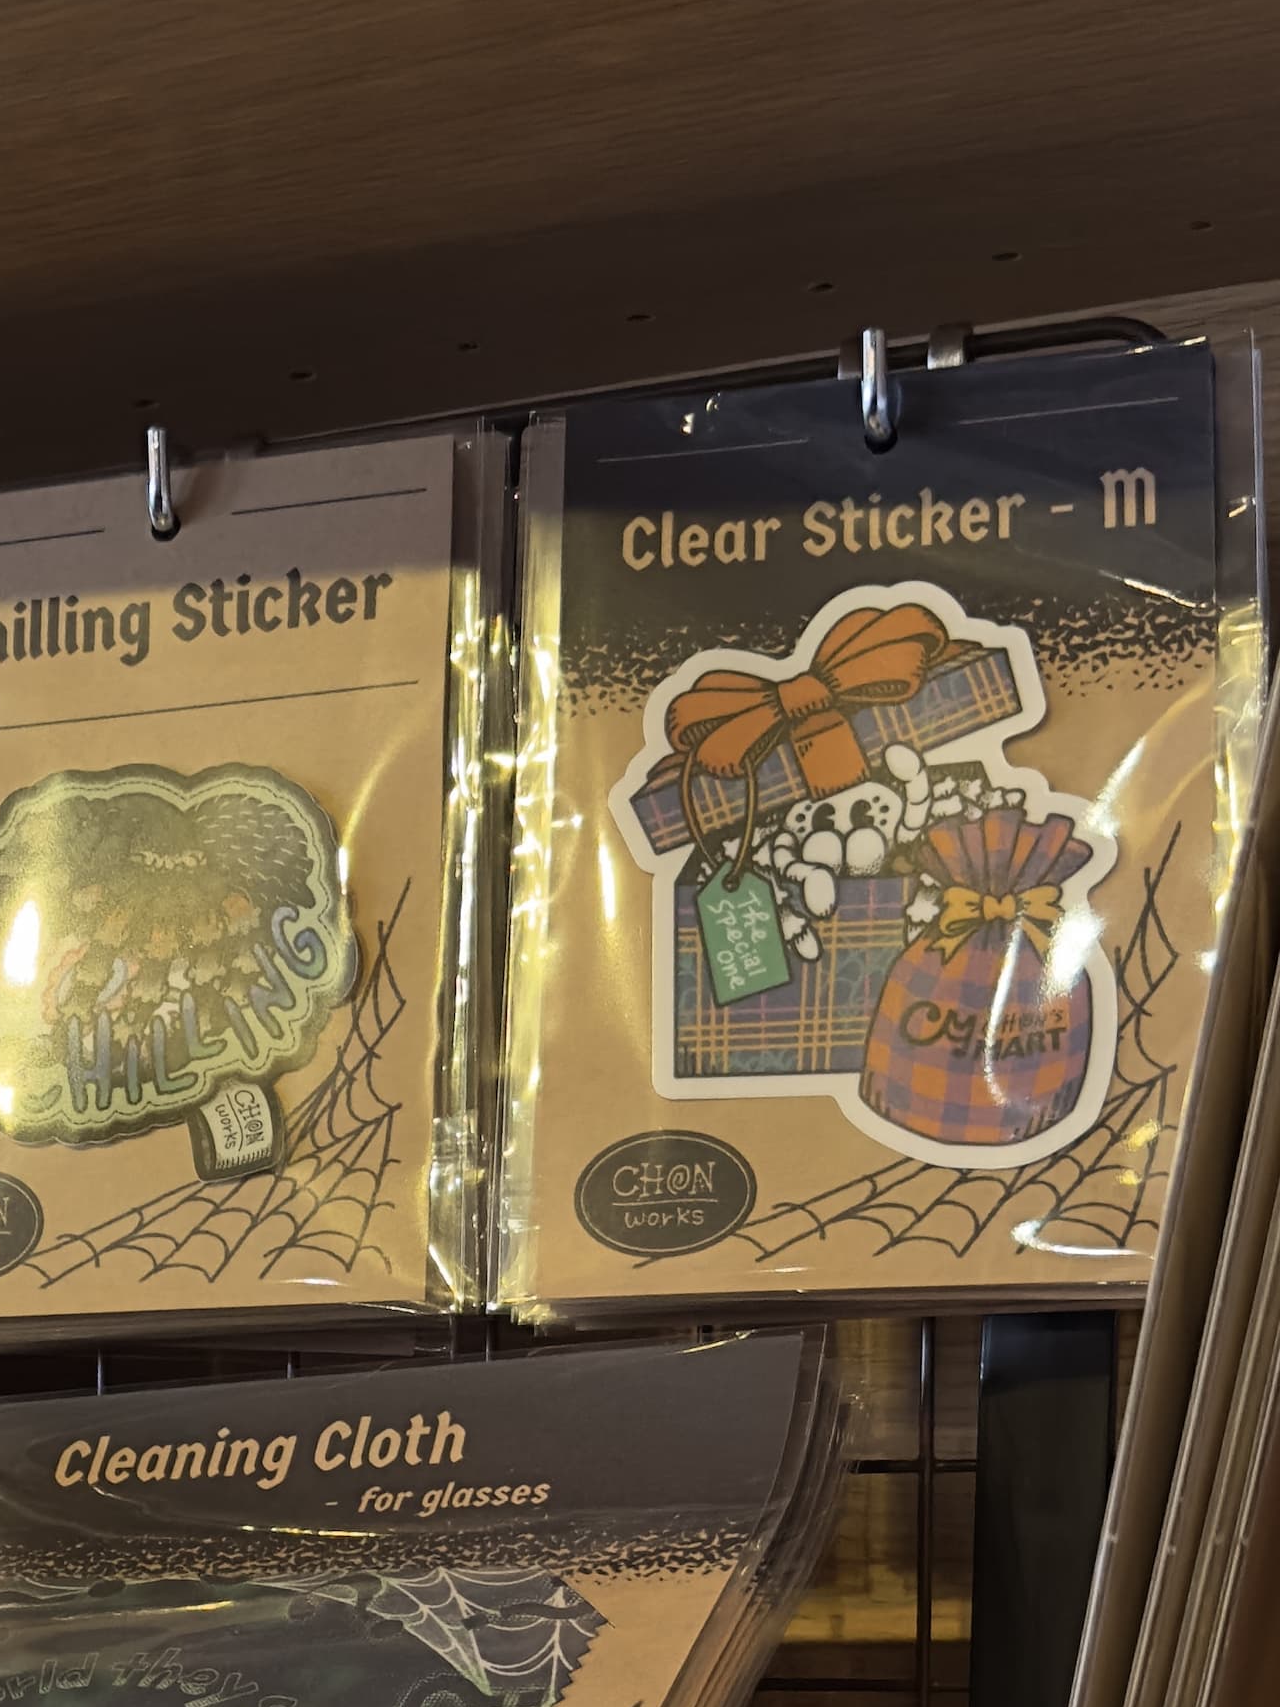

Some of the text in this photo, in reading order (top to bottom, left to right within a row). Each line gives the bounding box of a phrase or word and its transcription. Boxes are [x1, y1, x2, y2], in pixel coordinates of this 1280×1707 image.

[622, 488, 1026, 571] Clear Sticker
[172, 567, 393, 641] Sticker
[706, 899, 768, 977] Special
[737, 889, 771, 943] The
[717, 950, 746, 990] One
[215, 1104, 238, 1150] works
[624, 1207, 705, 1231] works
[54, 1410, 467, 1491] Cleaning Cloth
[358, 1477, 551, 1520] for glasses
